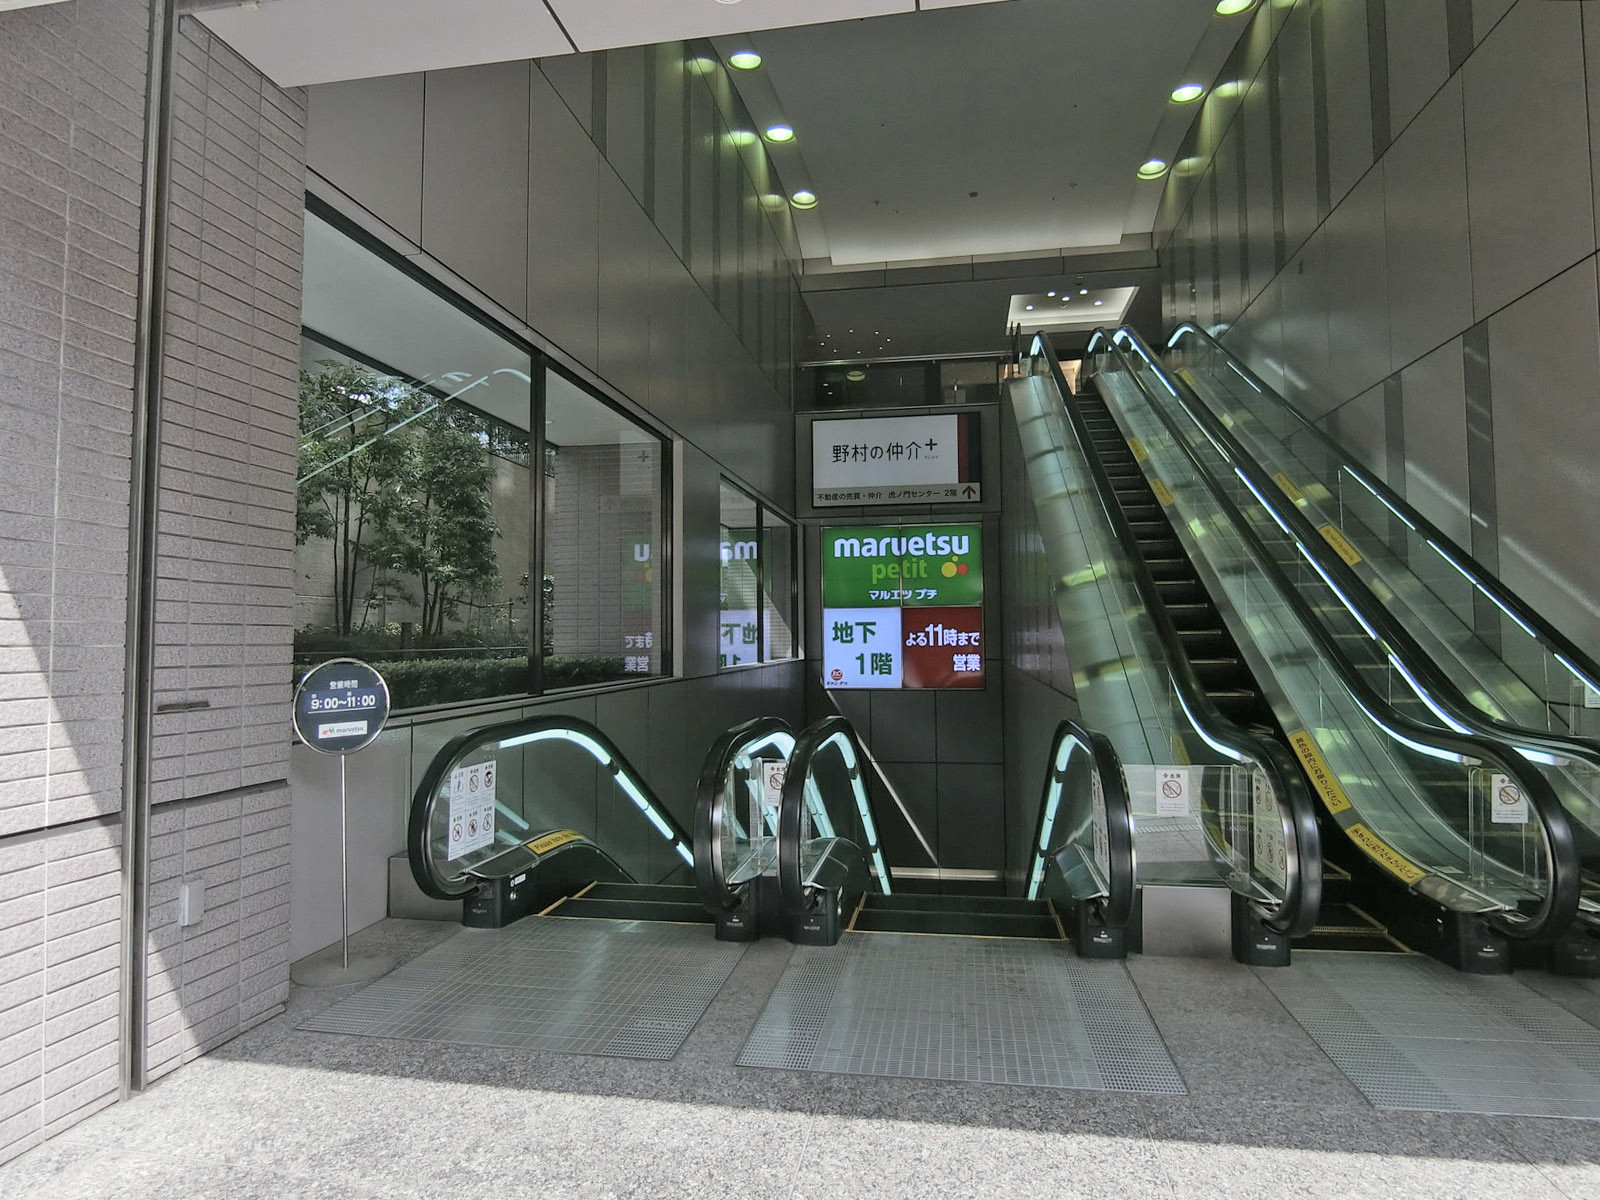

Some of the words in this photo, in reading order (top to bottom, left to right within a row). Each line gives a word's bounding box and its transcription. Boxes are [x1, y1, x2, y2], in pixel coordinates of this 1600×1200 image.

[888, 490, 941, 499] 虎ノ門センター
[944, 489, 958, 497] 2階
[834, 532, 969, 558] maruetsu
[871, 558, 928, 585] petit
[868, 588, 914, 601] マルエツ
[915, 588, 938, 600] プチ
[832, 621, 877, 644] 地下
[905, 623, 980, 647] よる11時まで
[855, 653, 893, 676] 1階
[952, 653, 981, 672] 営業
[329, 680, 359, 690] 営業時間
[336, 727, 363, 735] maruetsu
